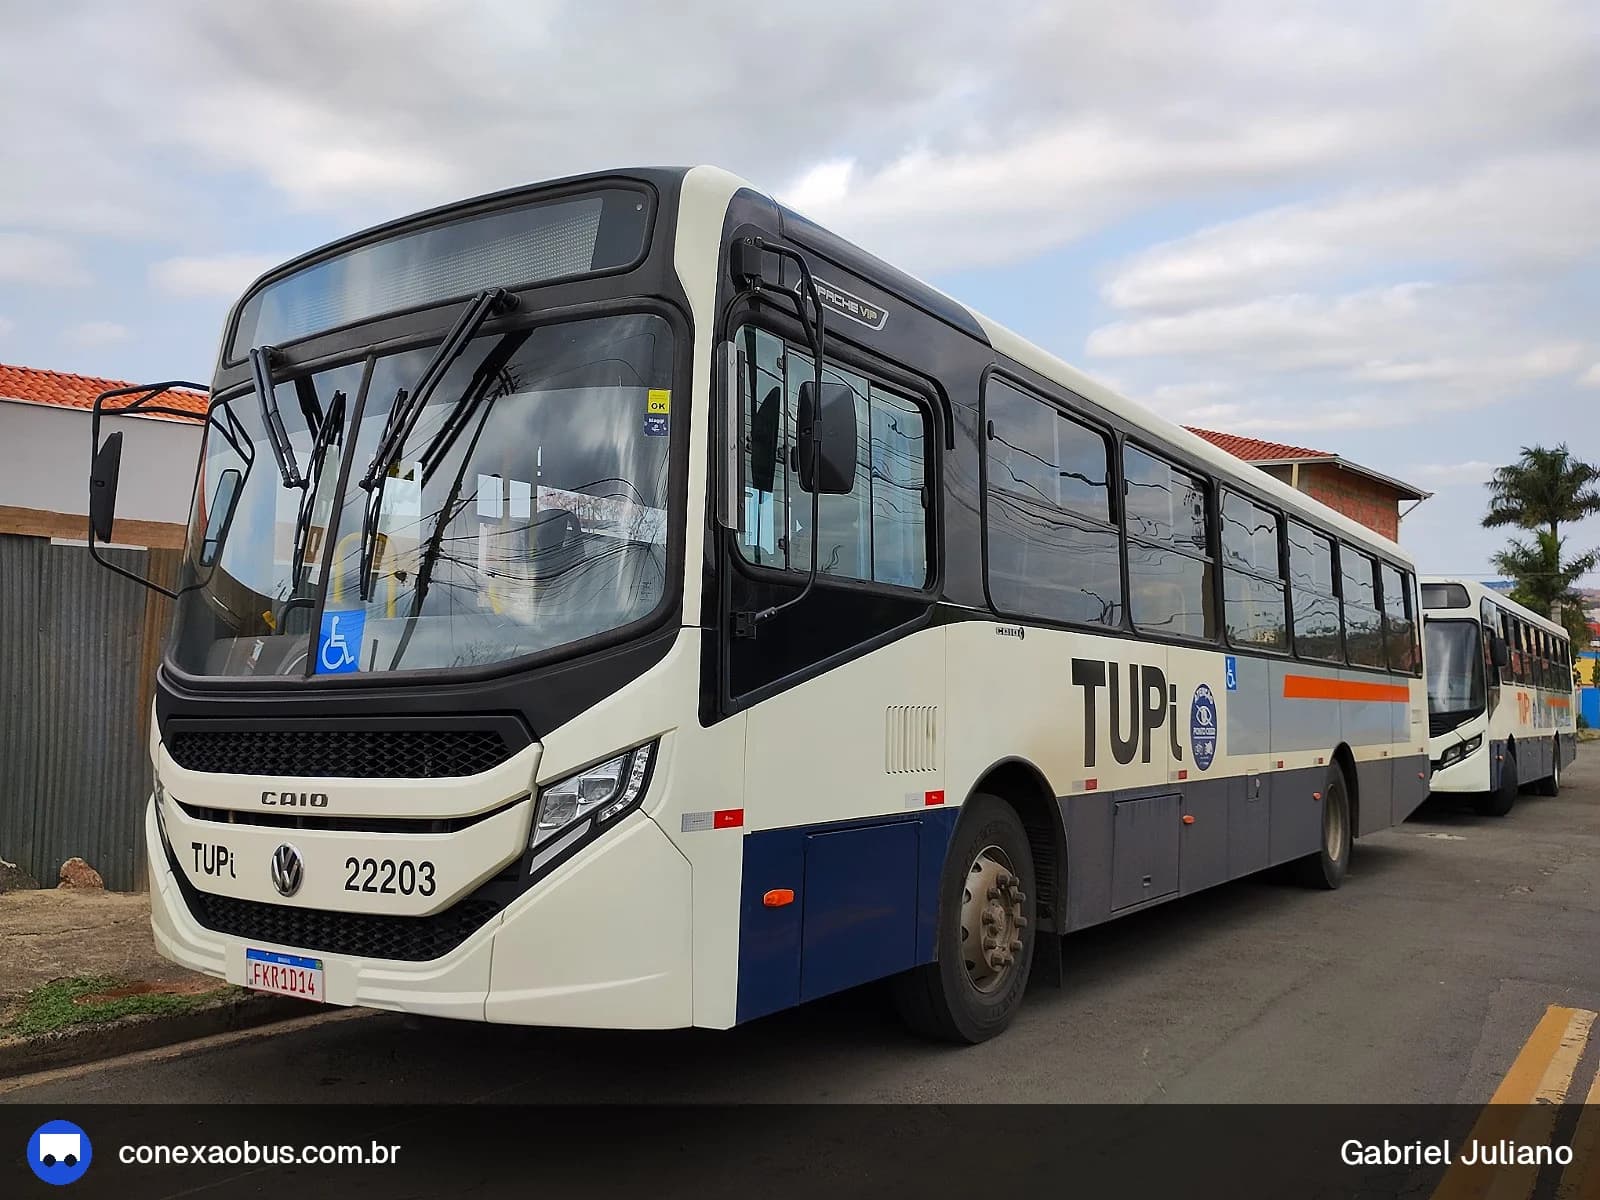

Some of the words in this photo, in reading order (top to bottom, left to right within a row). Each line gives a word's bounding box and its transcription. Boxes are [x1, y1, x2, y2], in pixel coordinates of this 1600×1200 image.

[814, 283, 858, 314] PACHE
[860, 304, 878, 320] VIP
[651, 402, 666, 410] OK
[261, 791, 328, 808] CAIO
[344, 856, 436, 896] 22203
[254, 962, 315, 995] FKR1D14
